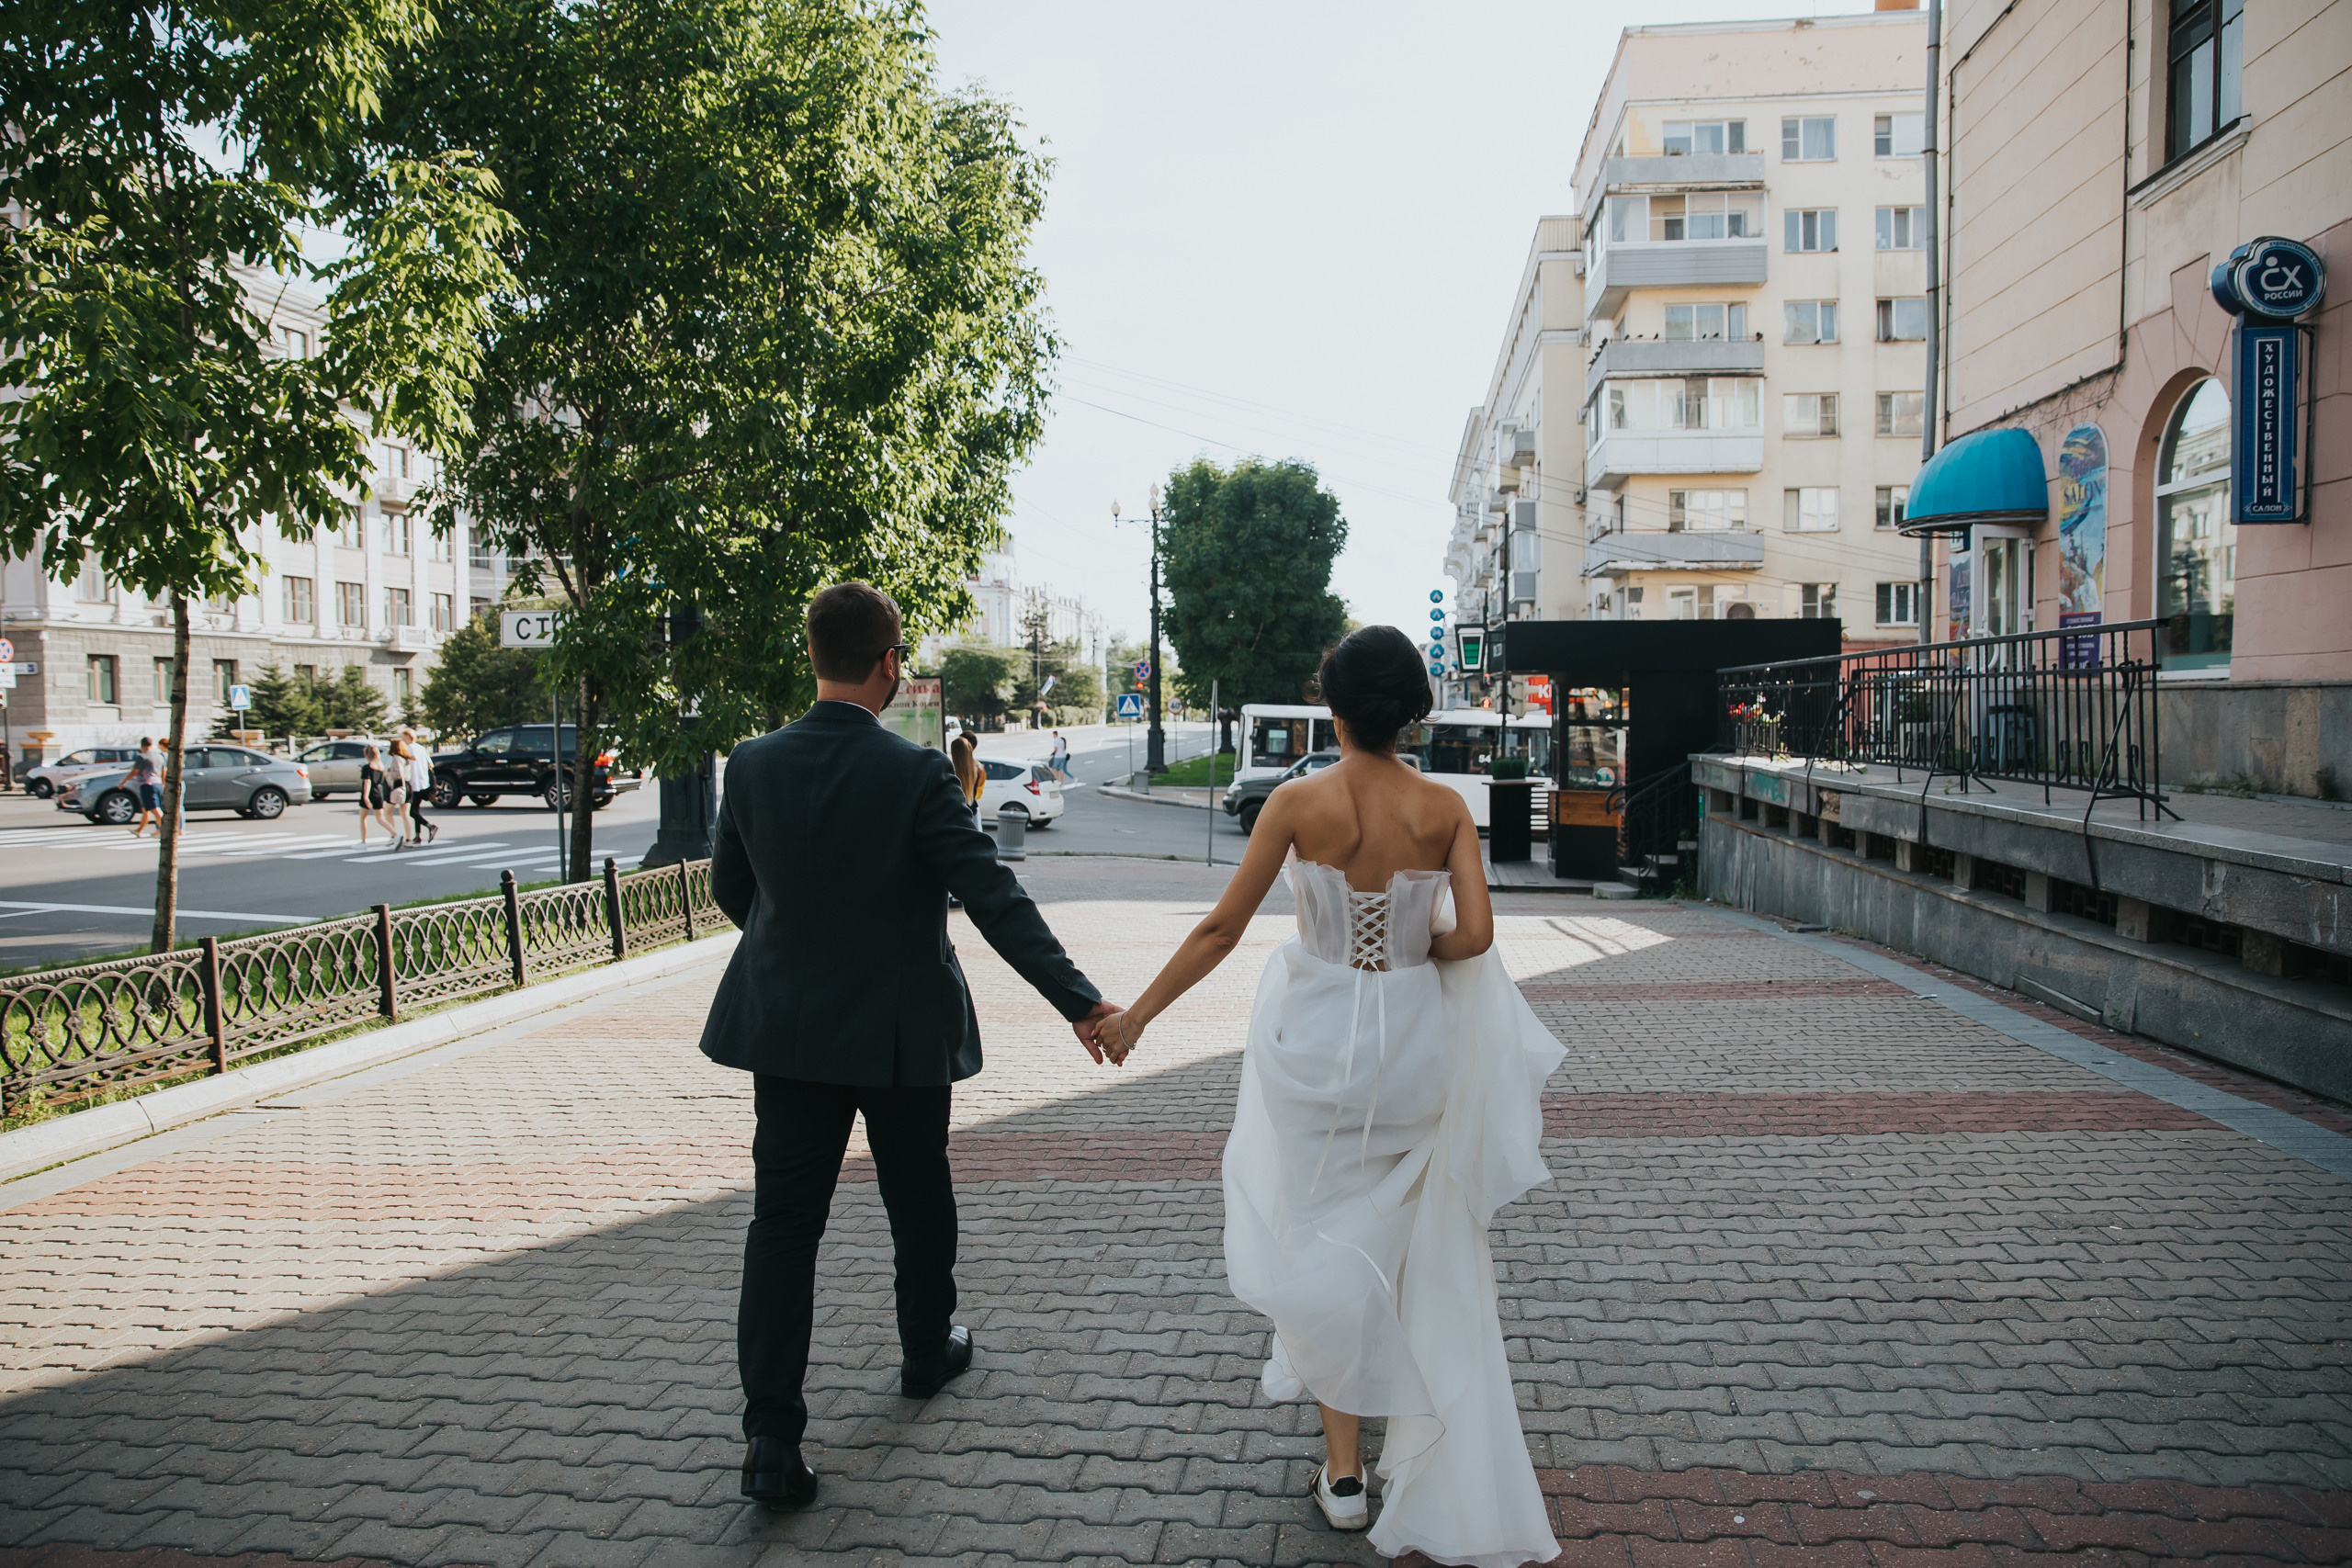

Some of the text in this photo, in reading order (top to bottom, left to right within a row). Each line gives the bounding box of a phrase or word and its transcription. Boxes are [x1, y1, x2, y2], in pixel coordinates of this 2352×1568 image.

[2264, 289, 2303, 300] РОССИИ
[2262, 344, 2275, 497] ХУДОЖЕСТВЕННЫЙ
[2064, 480, 2102, 505] SALON
